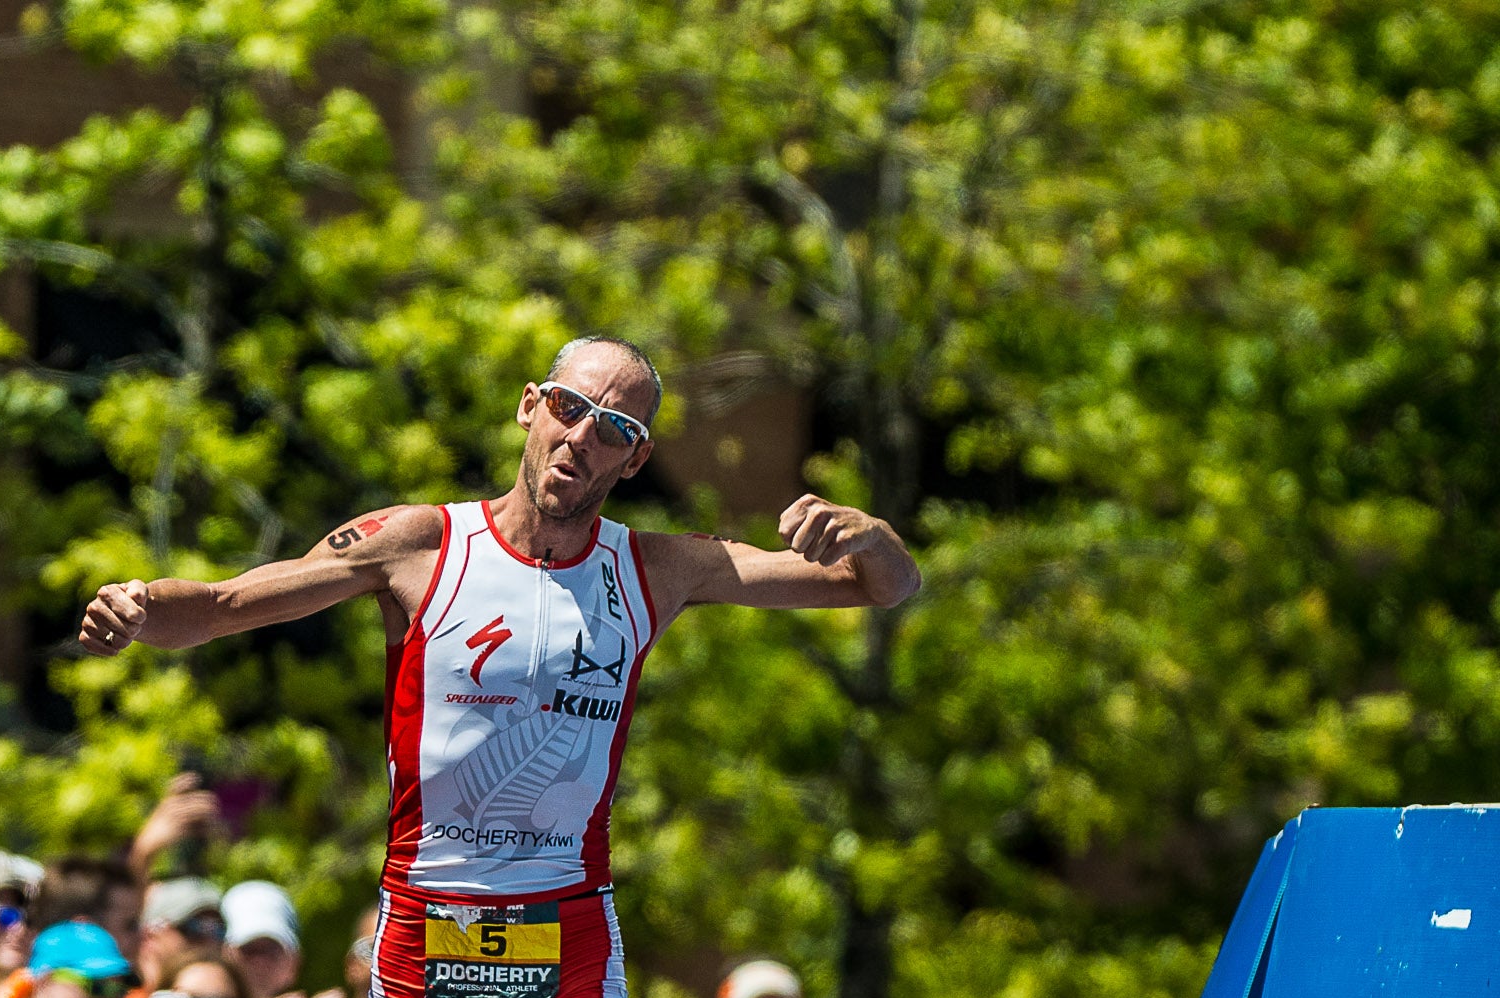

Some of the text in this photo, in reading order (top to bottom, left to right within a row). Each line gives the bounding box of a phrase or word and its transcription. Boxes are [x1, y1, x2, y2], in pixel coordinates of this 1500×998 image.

[327, 527, 362, 550] 5
[601, 561, 622, 621] 2XU
[444, 693, 518, 705] SPECIALIZED
[432, 824, 574, 848] DOCHERTY.kiwi
[479, 925, 507, 957] 5
[435, 962, 552, 983] DOCHERTY
[506, 984, 538, 992] ATHLETE
